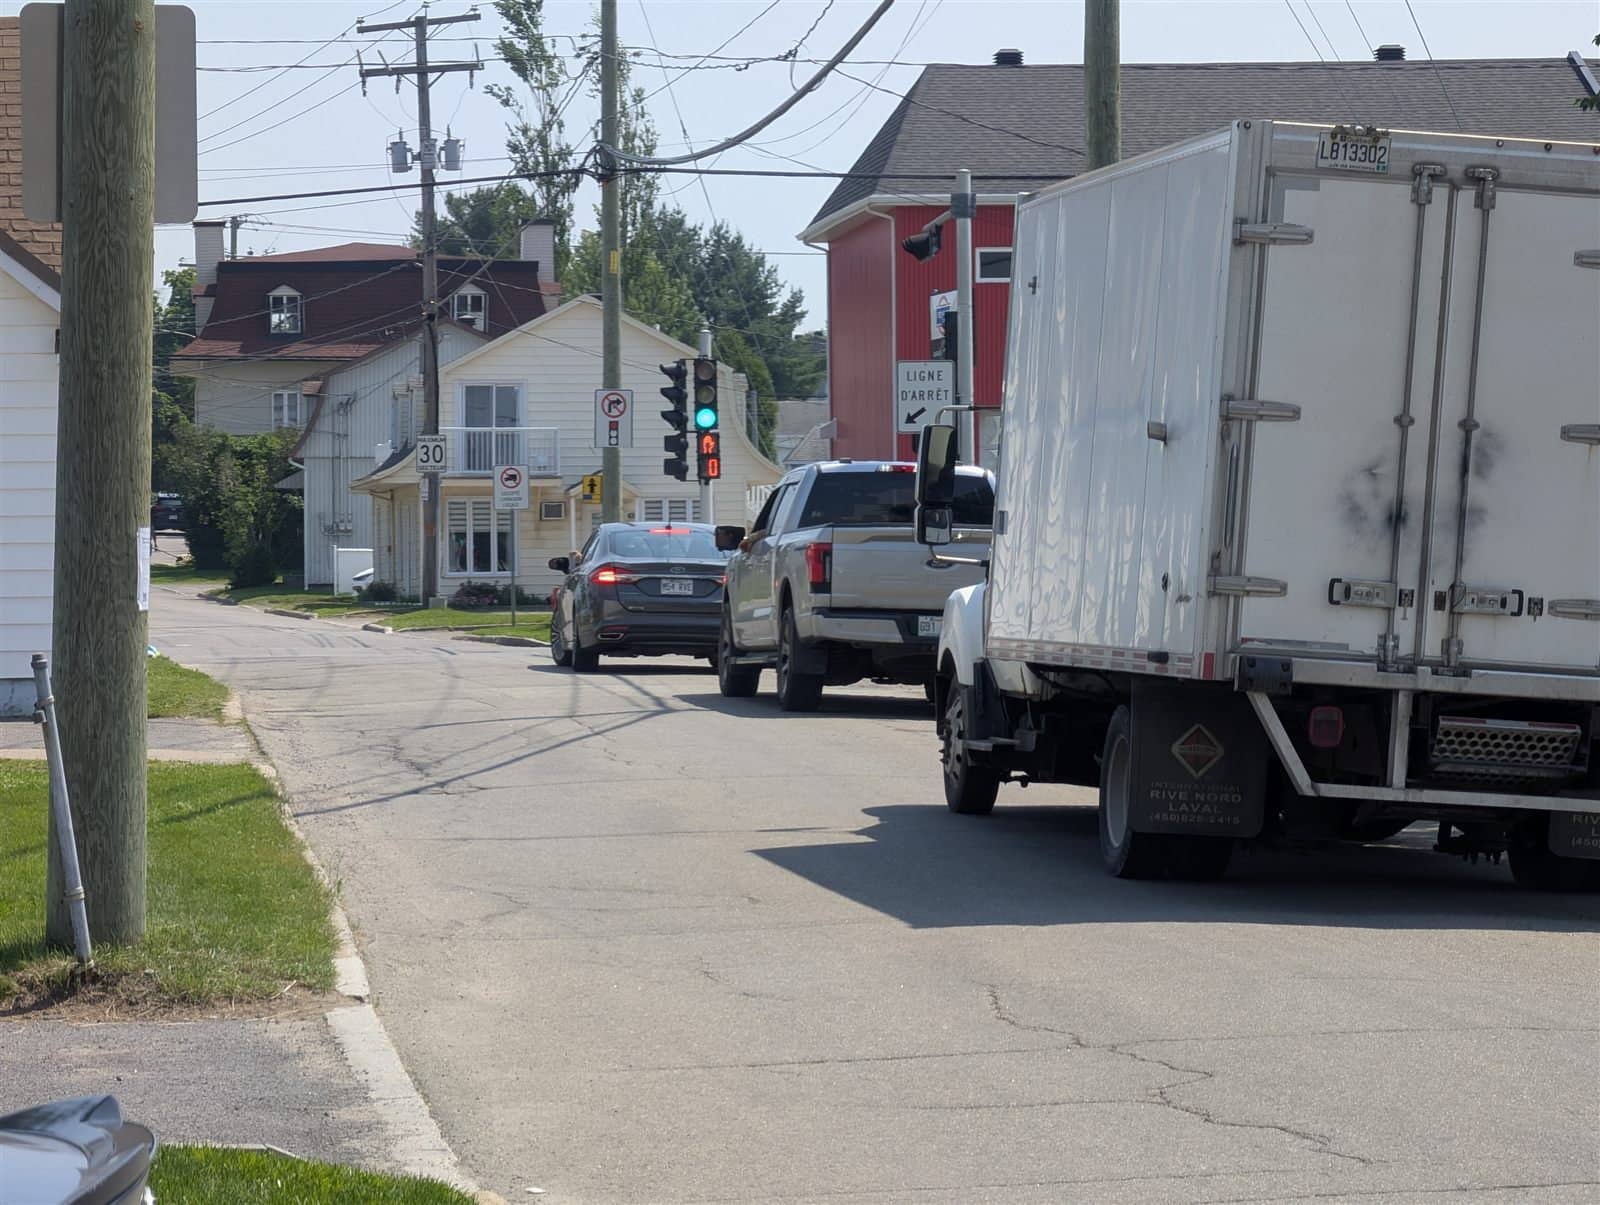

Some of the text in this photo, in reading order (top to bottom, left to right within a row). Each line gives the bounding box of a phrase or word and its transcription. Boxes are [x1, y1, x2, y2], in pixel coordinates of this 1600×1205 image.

[1320, 141, 1387, 164] L813302
[906, 370, 944, 382] LIGNE
[900, 388, 949, 401] D'ARRÊT
[419, 444, 443, 464] 30
[708, 458, 718, 477] 0
[1149, 790, 1242, 803] RIVE NORD
[1168, 801, 1222, 814] LAVAL
